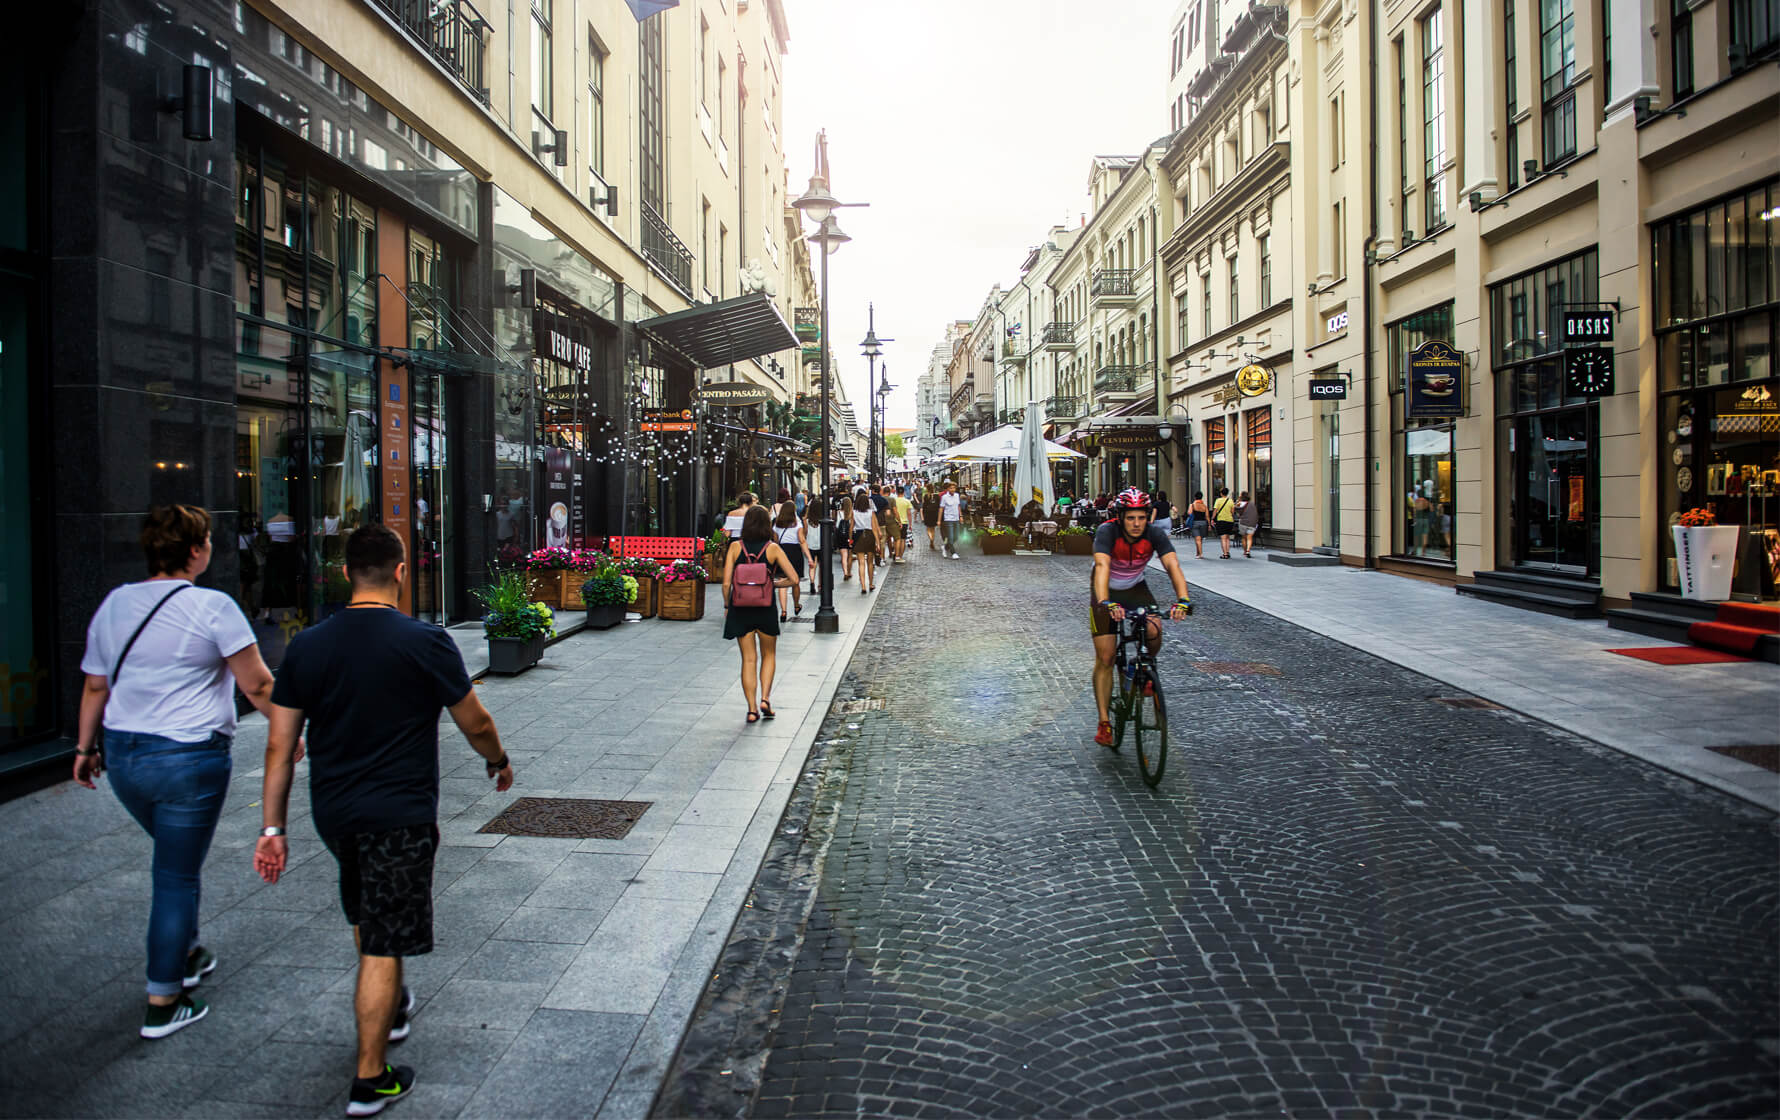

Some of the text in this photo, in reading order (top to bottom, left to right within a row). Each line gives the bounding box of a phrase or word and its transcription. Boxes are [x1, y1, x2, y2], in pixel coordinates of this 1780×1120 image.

[1328, 312, 1348, 333] IQOS
[1567, 318, 1610, 335] OKSAS
[551, 330, 572, 363] VERO
[732, 389, 767, 397] PASAŽAS
[1313, 386, 1344, 395] IQOS
